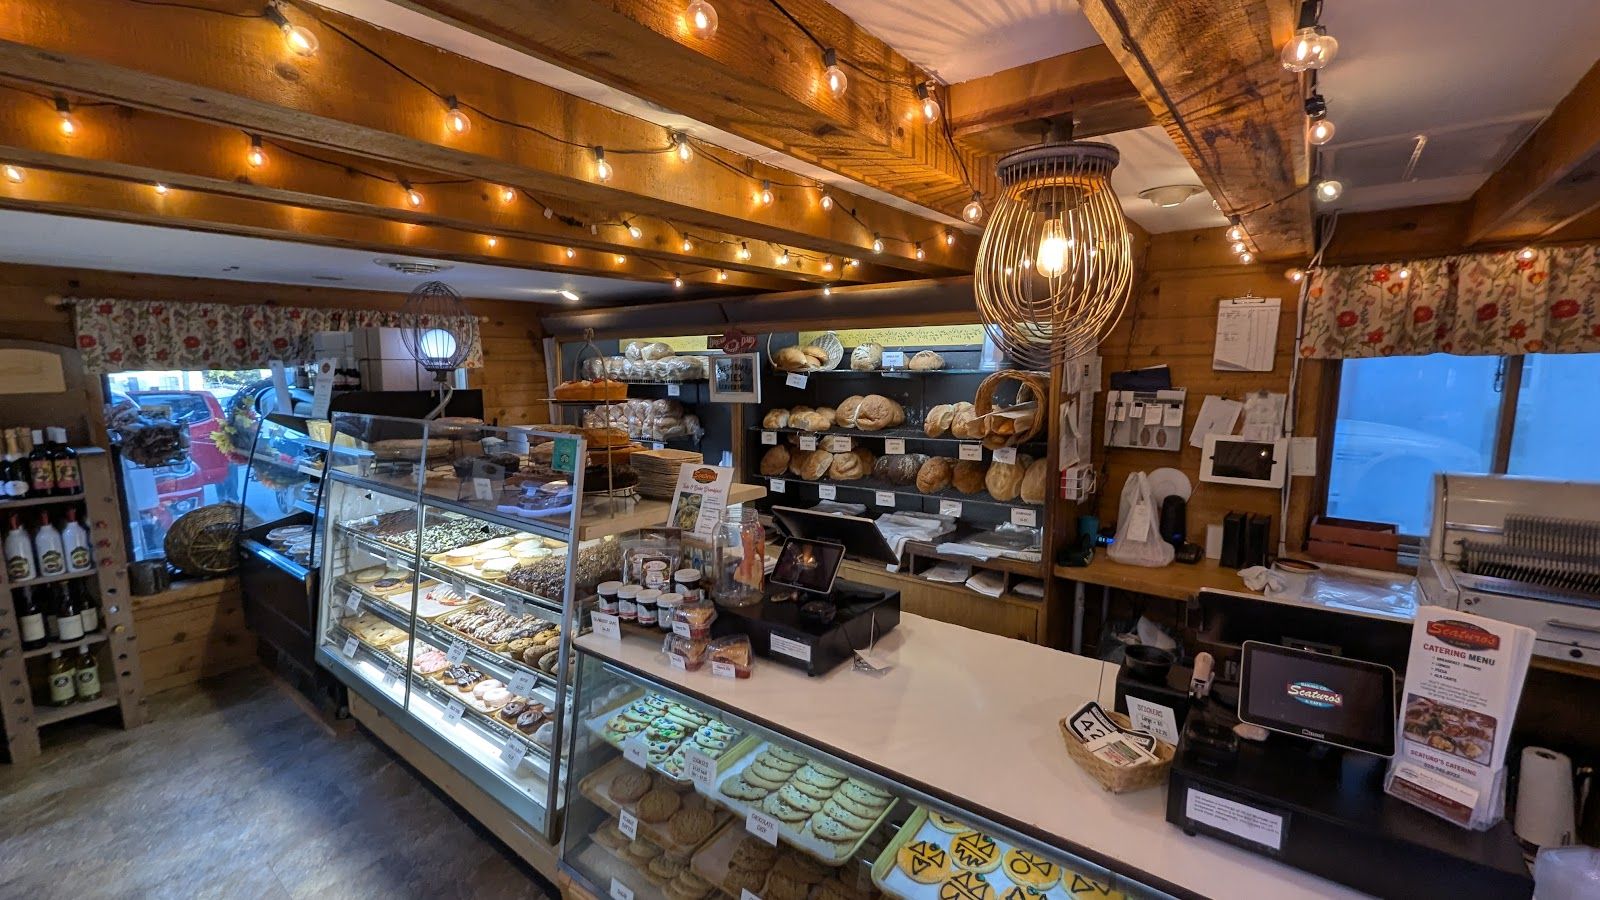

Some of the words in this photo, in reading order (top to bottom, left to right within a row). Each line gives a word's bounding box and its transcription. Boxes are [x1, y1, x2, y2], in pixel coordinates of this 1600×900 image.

[1430, 623, 1496, 647] Scaturo's
[1423, 643, 1467, 660] CATERING
[1468, 653, 1497, 667] MENU
[1287, 684, 1342, 704] Scaturo's
[1410, 749, 1445, 766] SCATURO'S
[1445, 761, 1477, 777] CATERING
